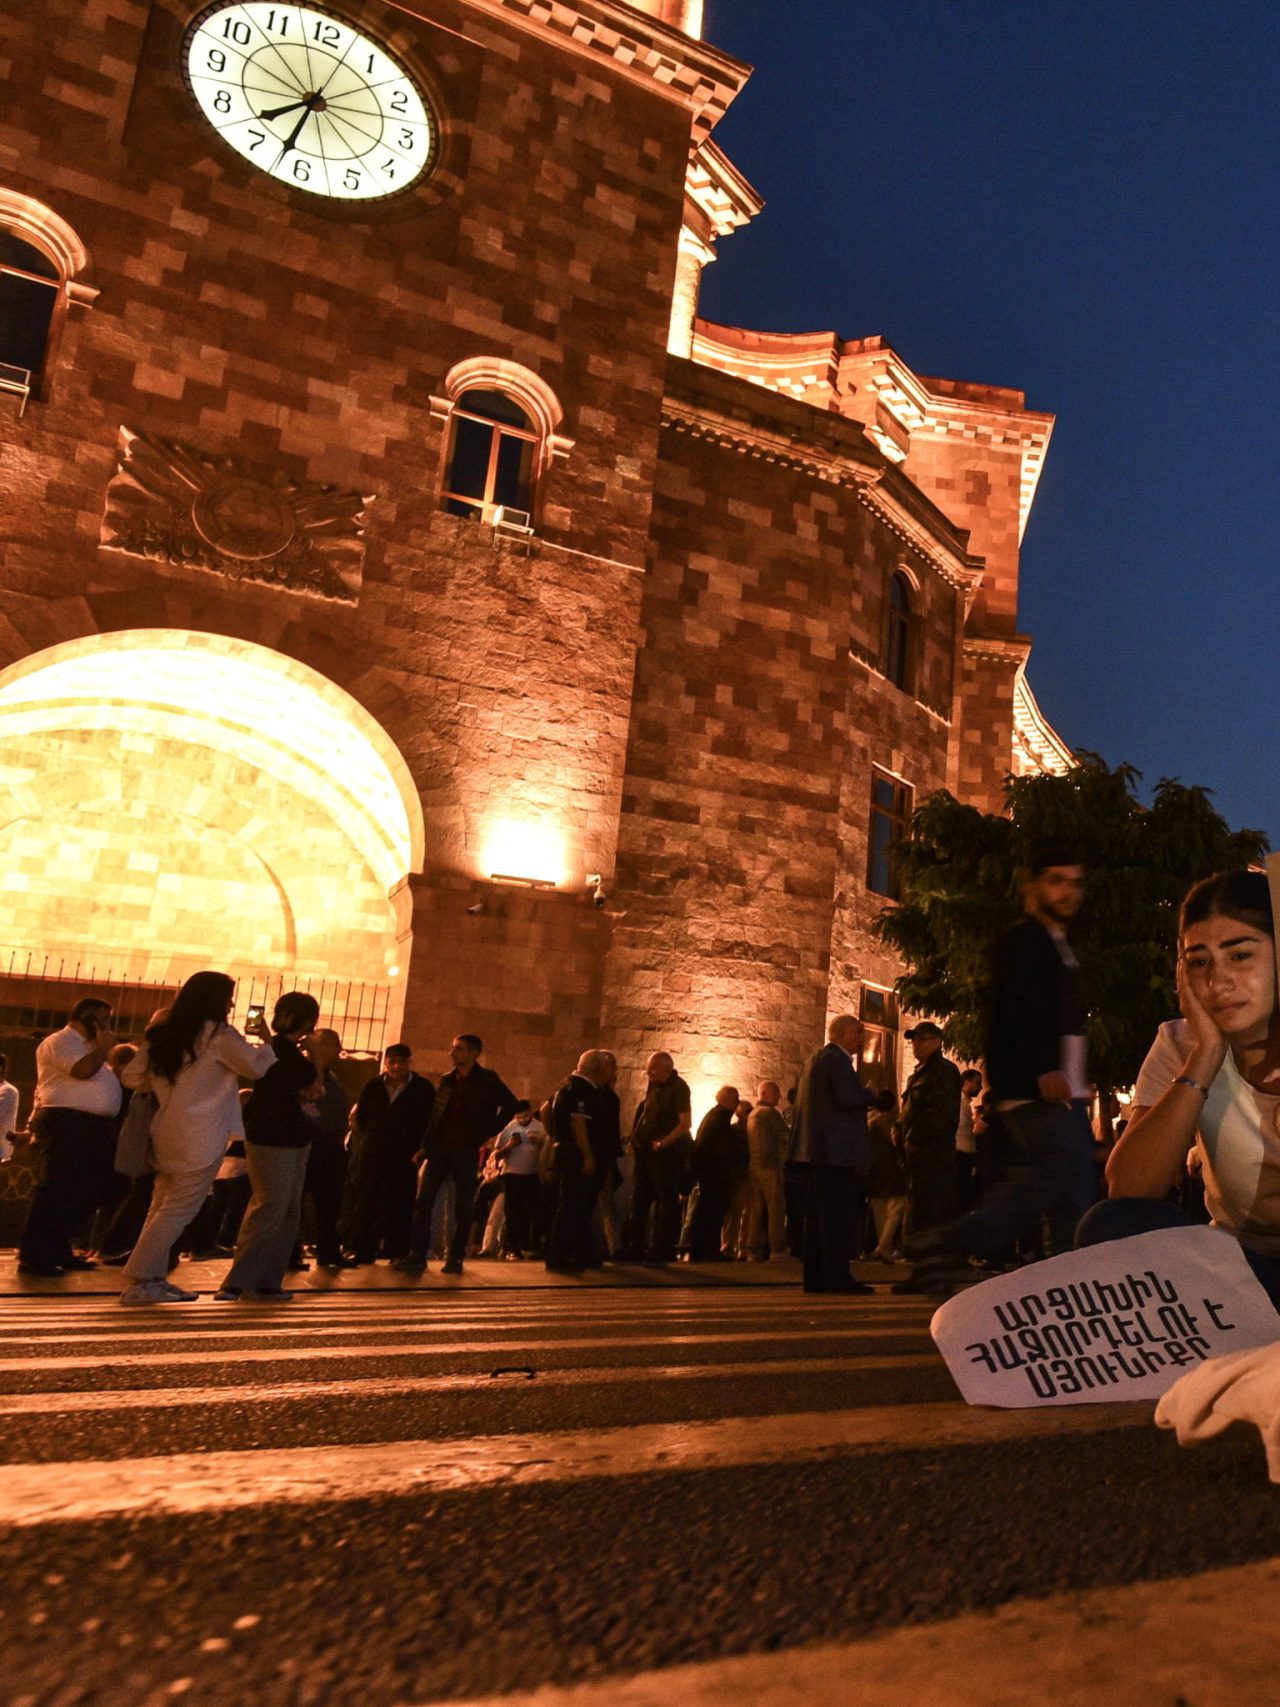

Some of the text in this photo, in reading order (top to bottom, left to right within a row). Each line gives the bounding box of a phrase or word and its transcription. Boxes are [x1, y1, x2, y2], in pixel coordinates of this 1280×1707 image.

[222, 17, 252, 46] 10
[266, 10, 289, 37] 11
[313, 20, 341, 50] 12
[206, 49, 227, 73] 9
[366, 54, 375, 74] 1
[213, 90, 232, 113] 8
[390, 91, 408, 113] 2
[248, 129, 266, 151] 7
[398, 128, 414, 150] 3
[293, 159, 311, 182] 6
[343, 169, 362, 191] 5
[380, 158, 395, 179] 4
[993, 1270, 1179, 1332] ԱՐՑԱԽԻՆ
[965, 1298, 1236, 1374] ՀԱՋՈՐԴԵԼՈՒ Է
